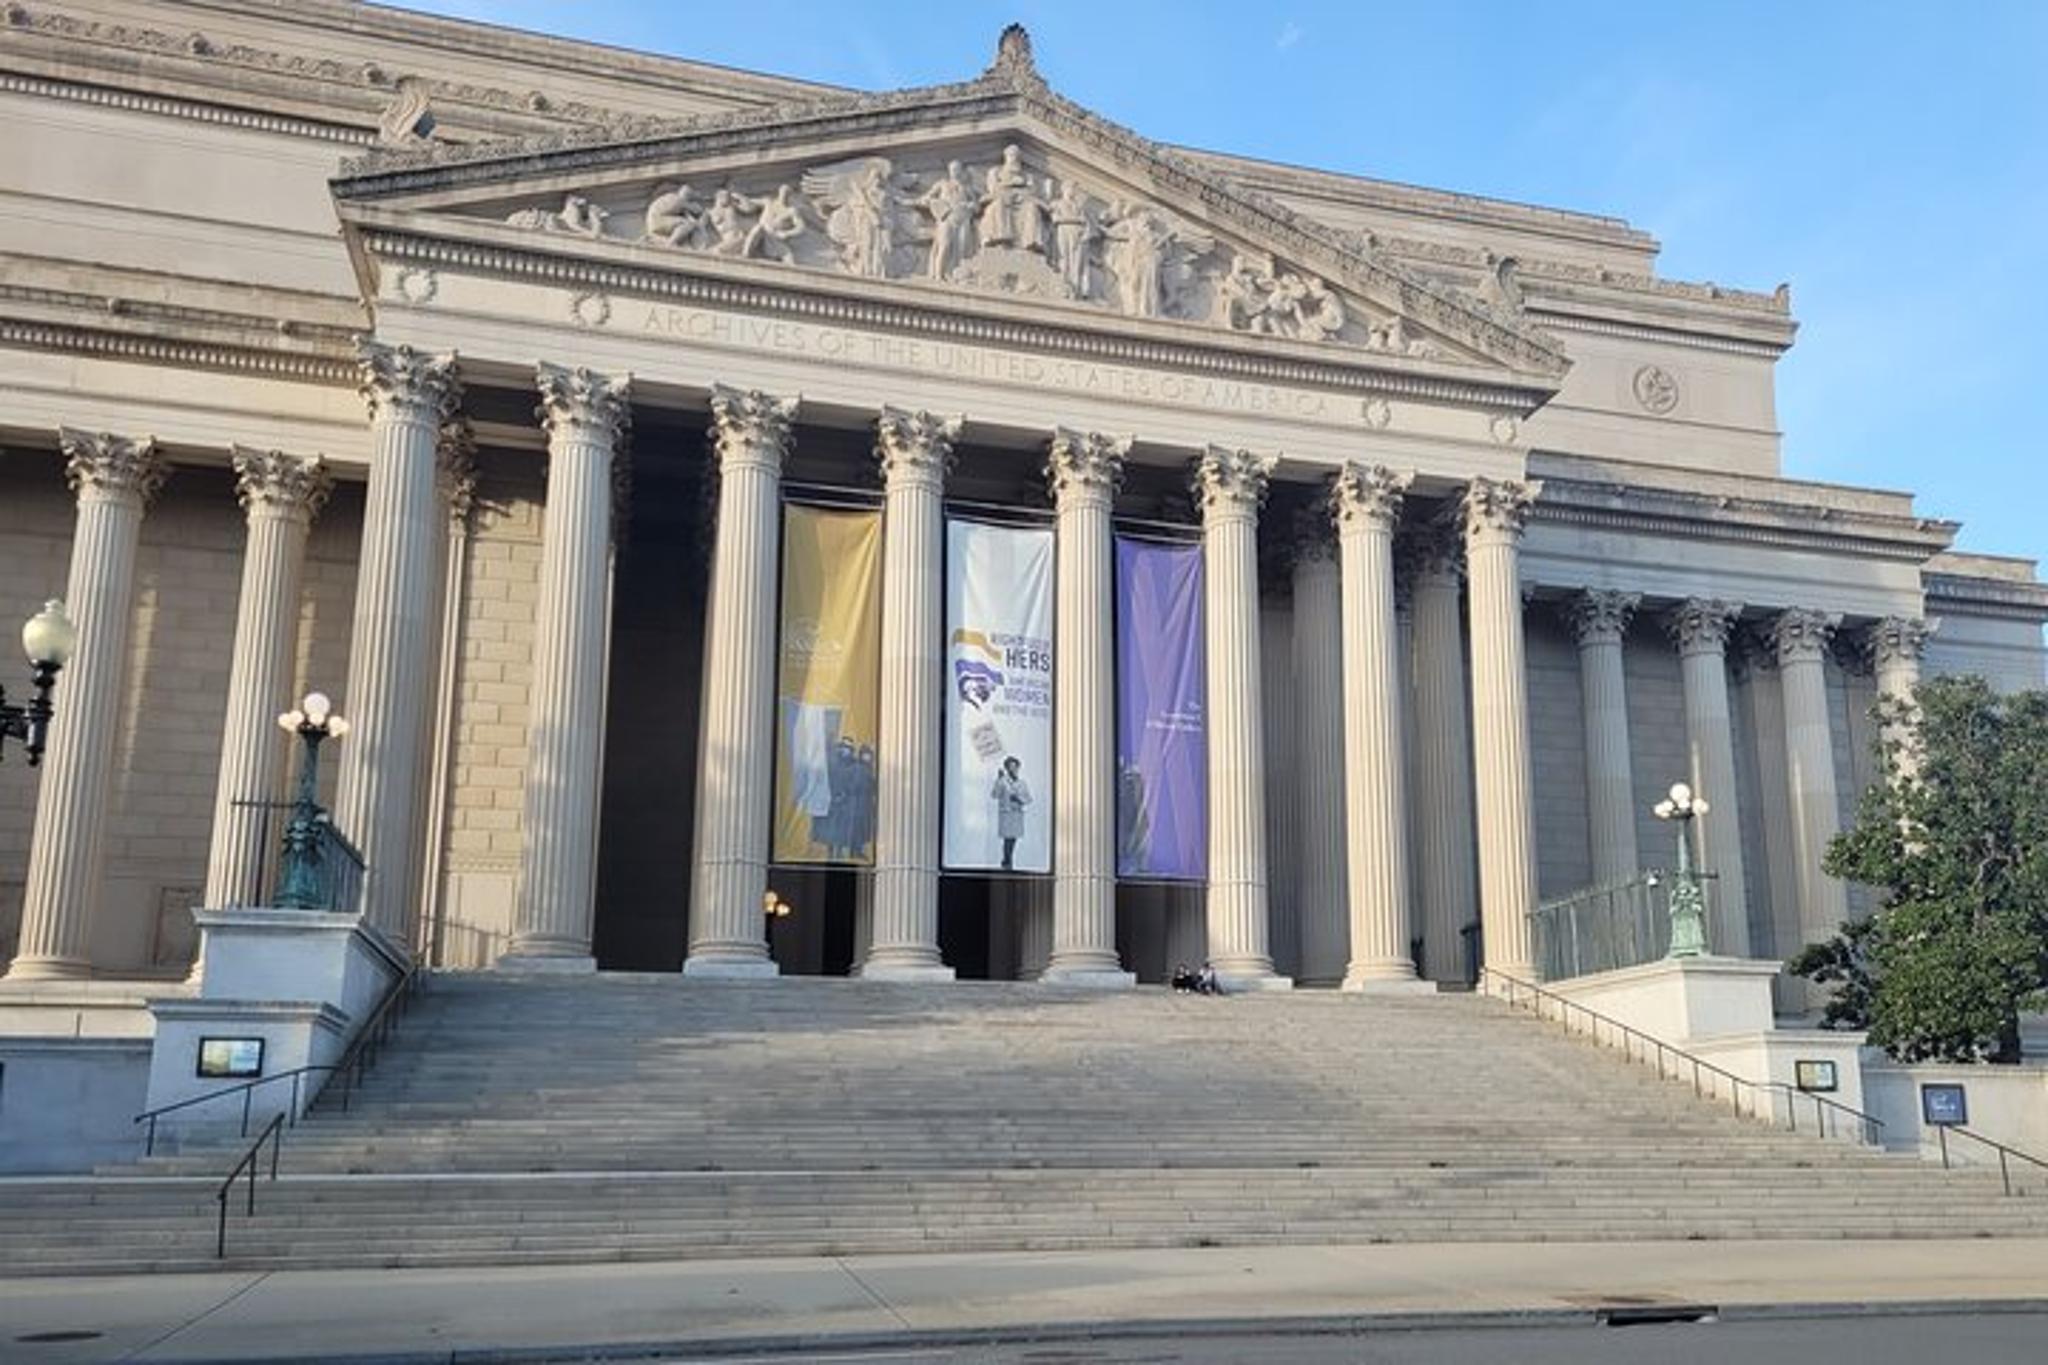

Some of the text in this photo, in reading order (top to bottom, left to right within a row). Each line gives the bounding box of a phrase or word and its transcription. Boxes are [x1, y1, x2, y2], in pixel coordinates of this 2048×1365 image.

[645, 307, 1328, 417] ARCHIVES OF THE UNITED STATES OF AMERICA
[1006, 648, 1050, 672] HERS
